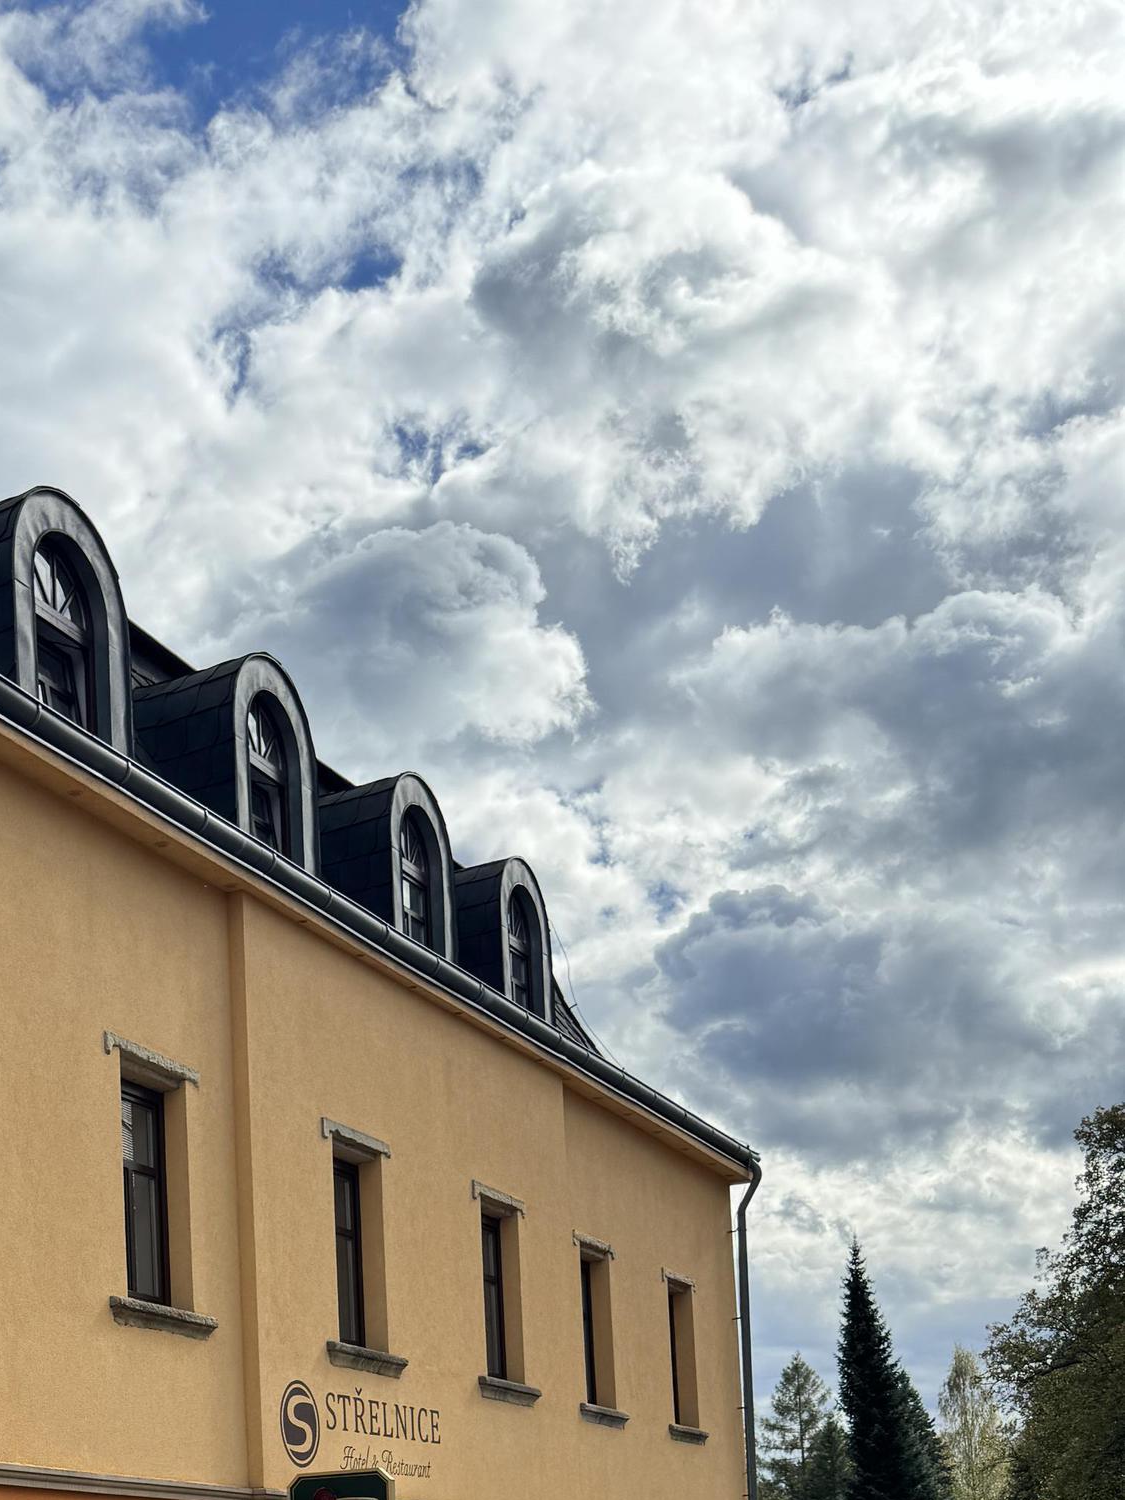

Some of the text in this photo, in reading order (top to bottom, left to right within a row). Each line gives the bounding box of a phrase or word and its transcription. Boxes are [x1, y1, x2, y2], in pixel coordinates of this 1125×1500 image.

[325, 1387, 441, 1444] STŘELNICE
[340, 1445, 370, 1470] Hotel
[381, 1449, 431, 1479] Restaurant
